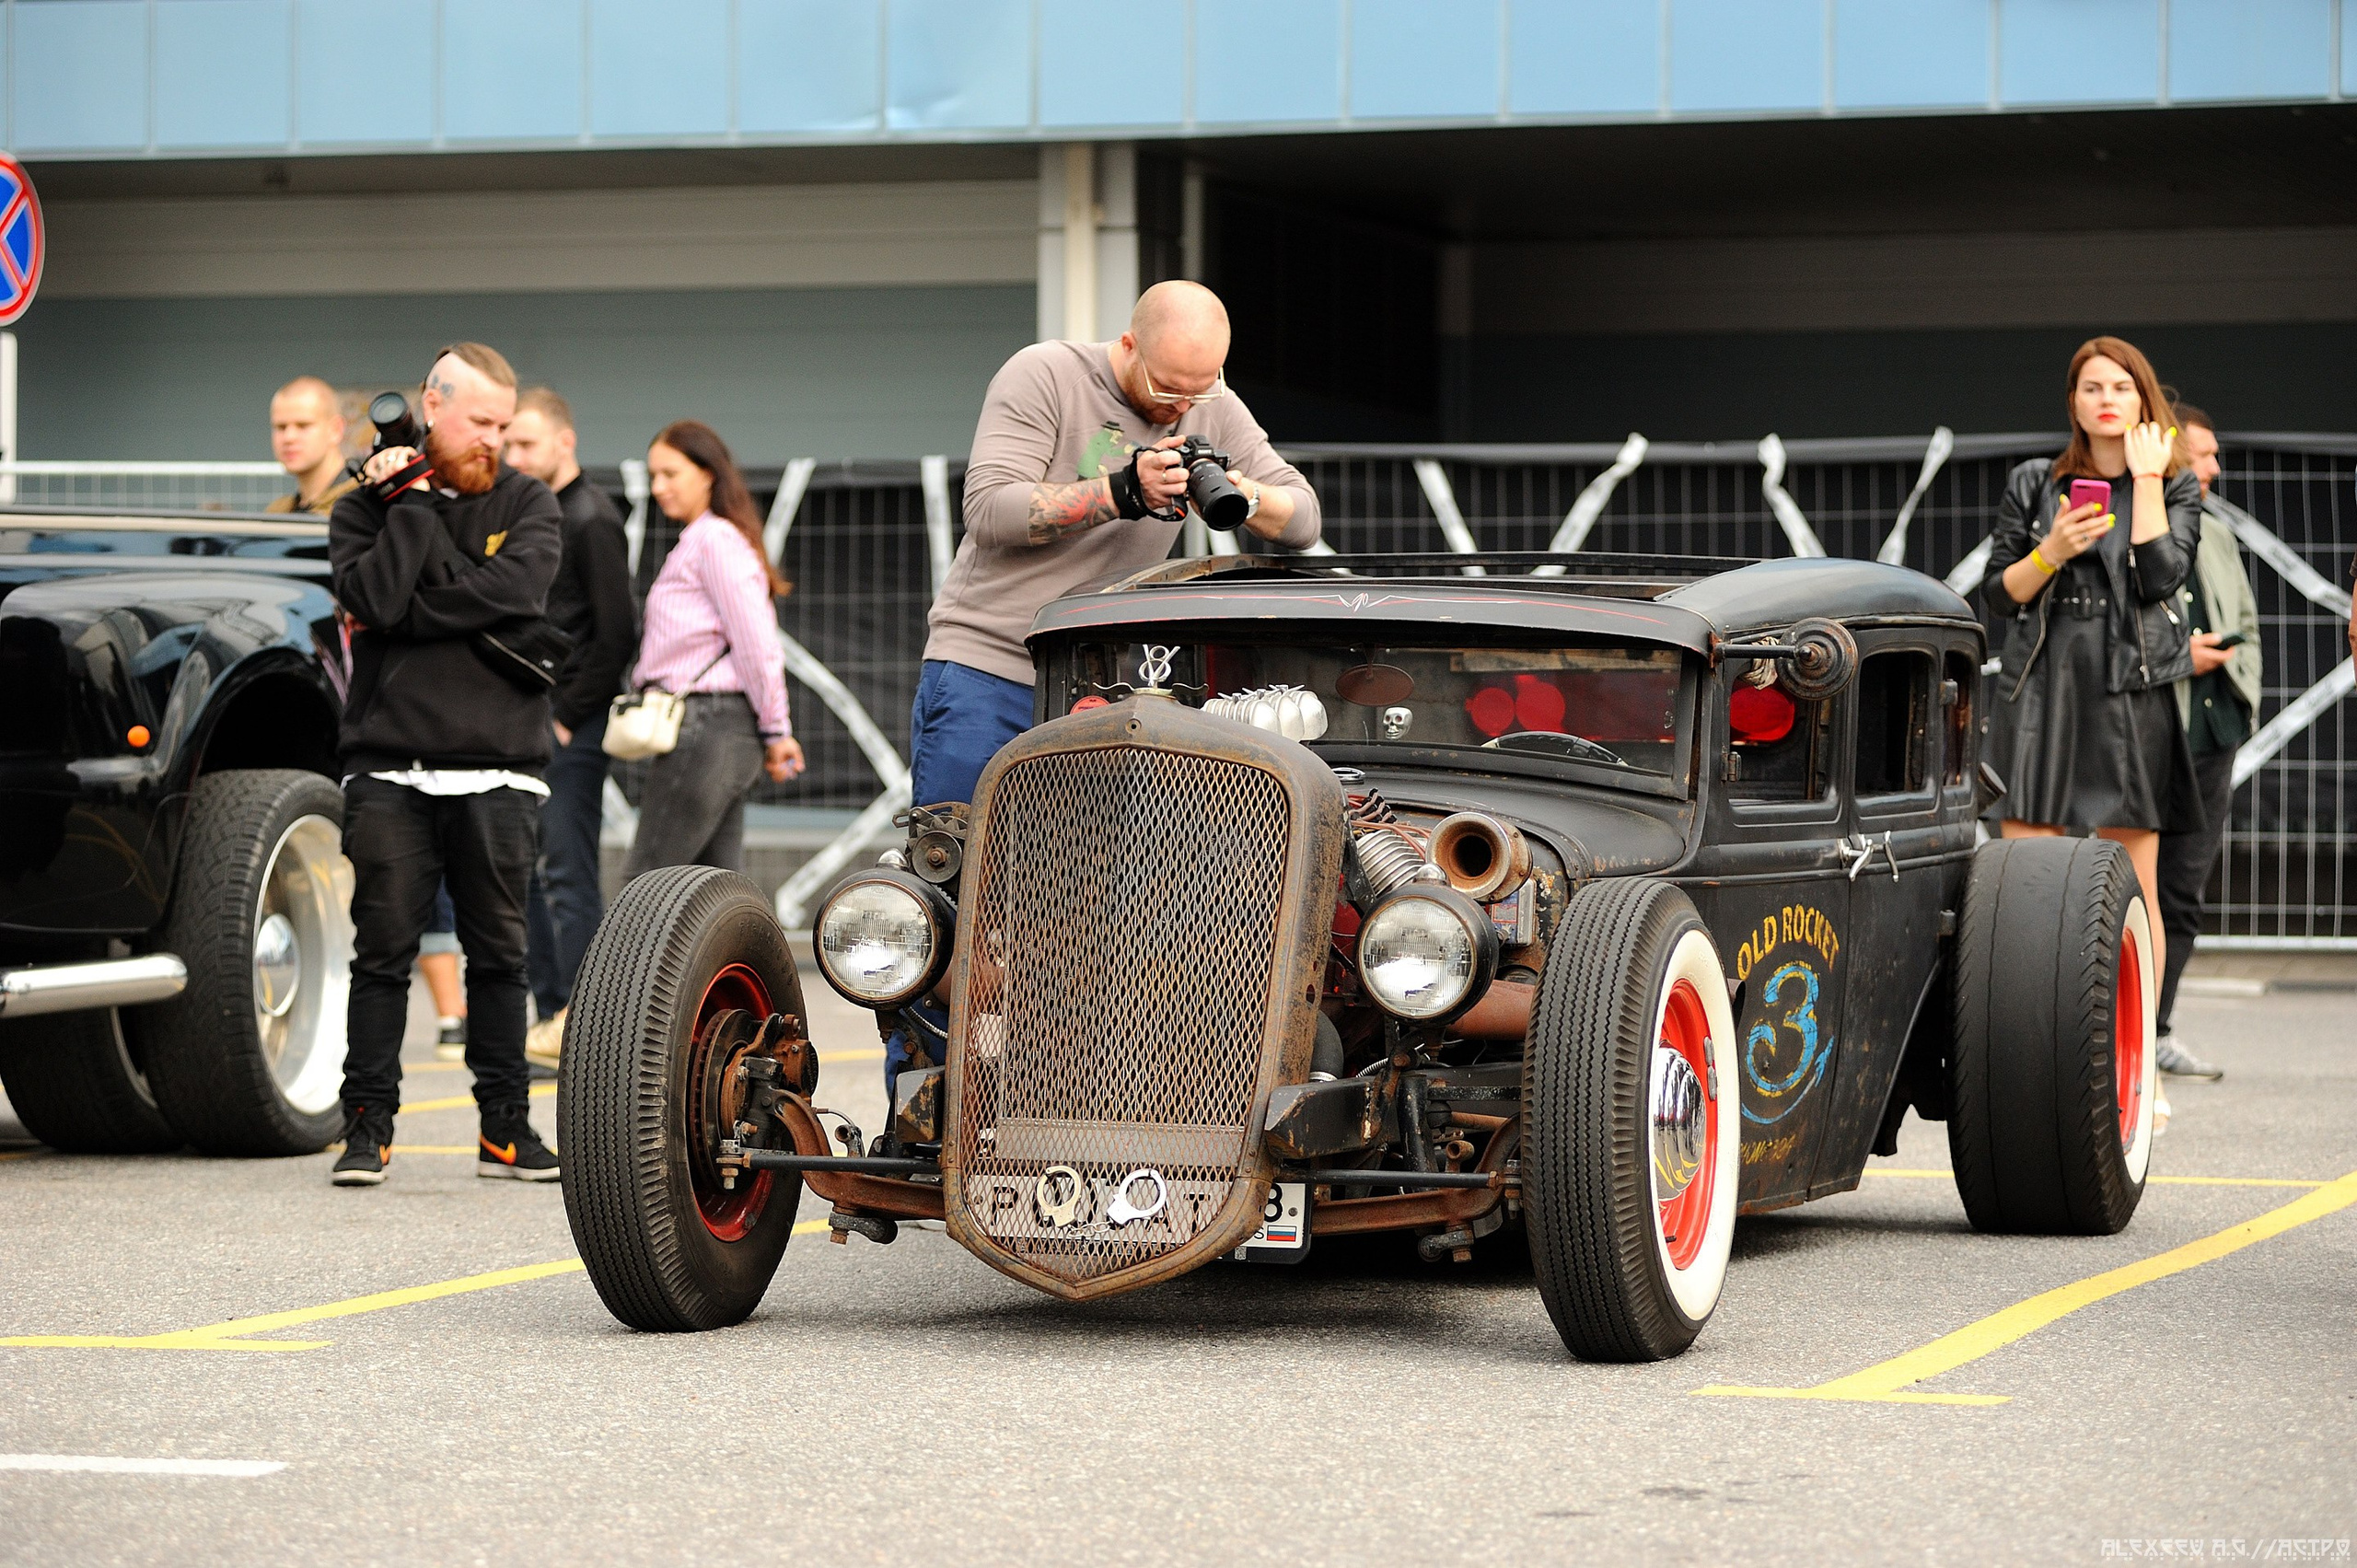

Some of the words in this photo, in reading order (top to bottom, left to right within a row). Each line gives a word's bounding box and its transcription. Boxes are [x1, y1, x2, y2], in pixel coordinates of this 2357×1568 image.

[1737, 915, 1778, 982] OLD
[1782, 903, 1840, 973] ROCKET
[1745, 960, 1820, 1098] 3
